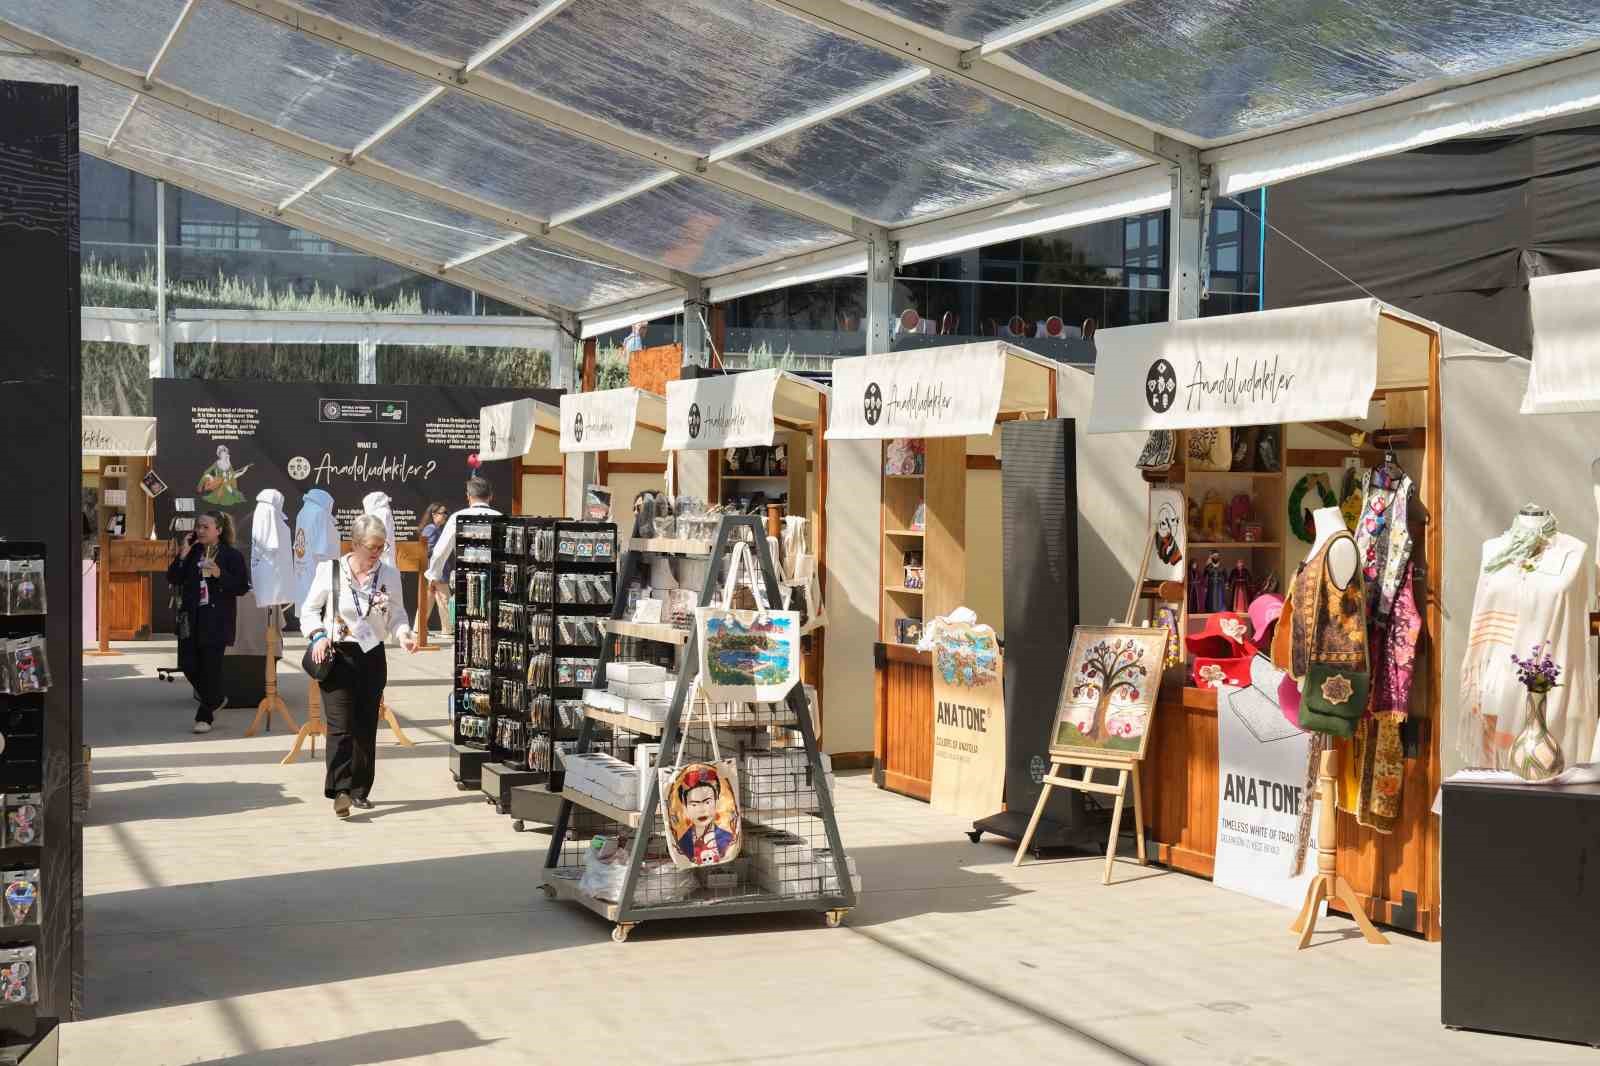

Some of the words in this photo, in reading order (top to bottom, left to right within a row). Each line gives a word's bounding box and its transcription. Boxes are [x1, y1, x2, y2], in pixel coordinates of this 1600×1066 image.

[1186, 354, 1296, 412] Anadoludakiler
[937, 701, 987, 732] ANATONE
[1222, 818, 1249, 834] TIMELESS
[1249, 824, 1269, 838] WHITE
[1269, 828, 1278, 840] OF
